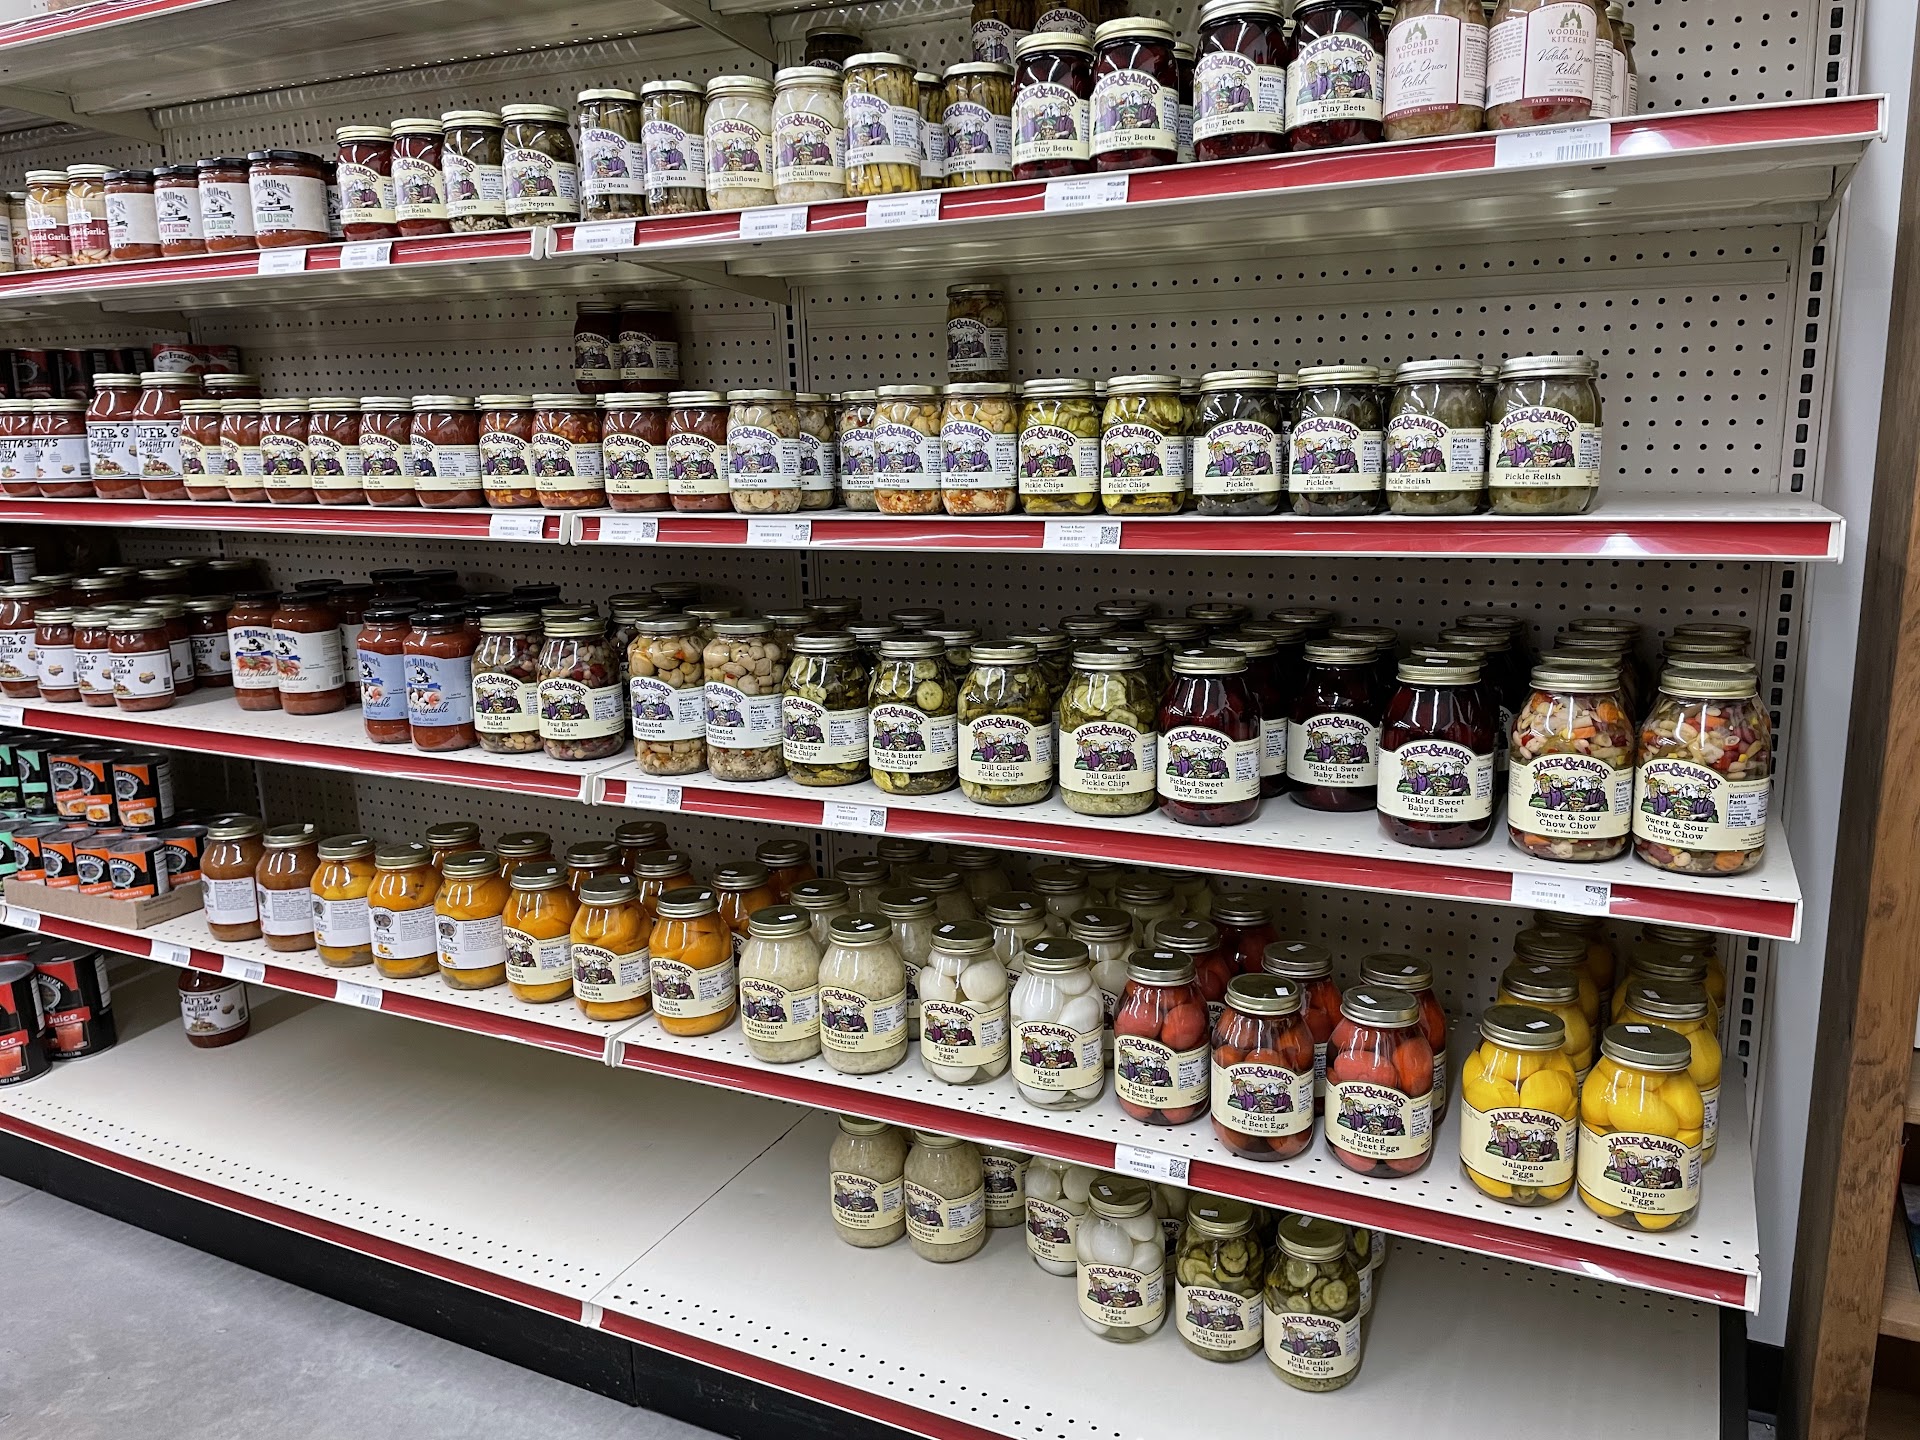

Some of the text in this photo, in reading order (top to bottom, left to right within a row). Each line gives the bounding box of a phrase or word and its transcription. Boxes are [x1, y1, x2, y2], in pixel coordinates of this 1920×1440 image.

[1395, 38, 1439, 52] WOODSIDE
[1551, 36, 1587, 44] KITCHEN
[1399, 46, 1434, 59] KITCHEN
[1537, 47, 1569, 62] Vidalia
[1556, 62, 1581, 76] Relish
[1222, 118, 1245, 126] Beets
[169, 352, 195, 364] Fratelli
[1044, 481, 1064, 489] Chips
[1130, 481, 1150, 489] Chips
[1309, 764, 1338, 772] Pickled
[978, 770, 1000, 778] Pickle
[1314, 771, 1359, 780] Baby Beets
[1169, 777, 1195, 787] Pickled
[1174, 785, 1193, 795] Baby
[1402, 795, 1435, 805] Pickled
[1408, 804, 1430, 813] Baby
[1535, 810, 1601, 822] Sweet & Sour
[1539, 819, 1597, 830] Chow Chow
[1645, 814, 1670, 827] Sweet
[1684, 823, 1709, 833] Sour
[1647, 824, 1704, 841] Chow Chow
[659, 1004, 680, 1012] Peaches
[48, 1012, 78, 1024] Juice
[751, 1020, 783, 1030] Fashioned
[832, 1029, 864, 1040] Fashioned
[934, 1044, 959, 1054] Pickled
[939, 1052, 954, 1060] Eggs
[1033, 1068, 1060, 1076] Pickled
[1128, 1082, 1154, 1094] Pickled
[1120, 1085, 1168, 1102] Red Beet Eggs
[1245, 1112, 1275, 1122] Pickled
[1232, 1115, 1289, 1130] Red Beet Eggs
[1354, 1132, 1385, 1143] Pickled
[1341, 1135, 1400, 1153] Red Beet Eggs
[1502, 1160, 1544, 1171] Jalapeno
[1512, 1169, 1534, 1179] Eggs
[1620, 1186, 1665, 1199] Jalapeno
[1631, 1196, 1655, 1206] Eggs
[844, 1210, 874, 1219] Fashioned
[913, 1222, 940, 1234] Fashioned
[1038, 1245, 1052, 1254] Eggs
[1101, 1307, 1127, 1315] Pickled
[1105, 1313, 1122, 1321] Eggs
[1195, 1327, 1233, 1339] Dill Garlic
[1192, 1332, 1236, 1345] Pickle Chips
[1291, 1355, 1330, 1366] Dill Garlic
[1287, 1359, 1334, 1373] Pickle Chips
